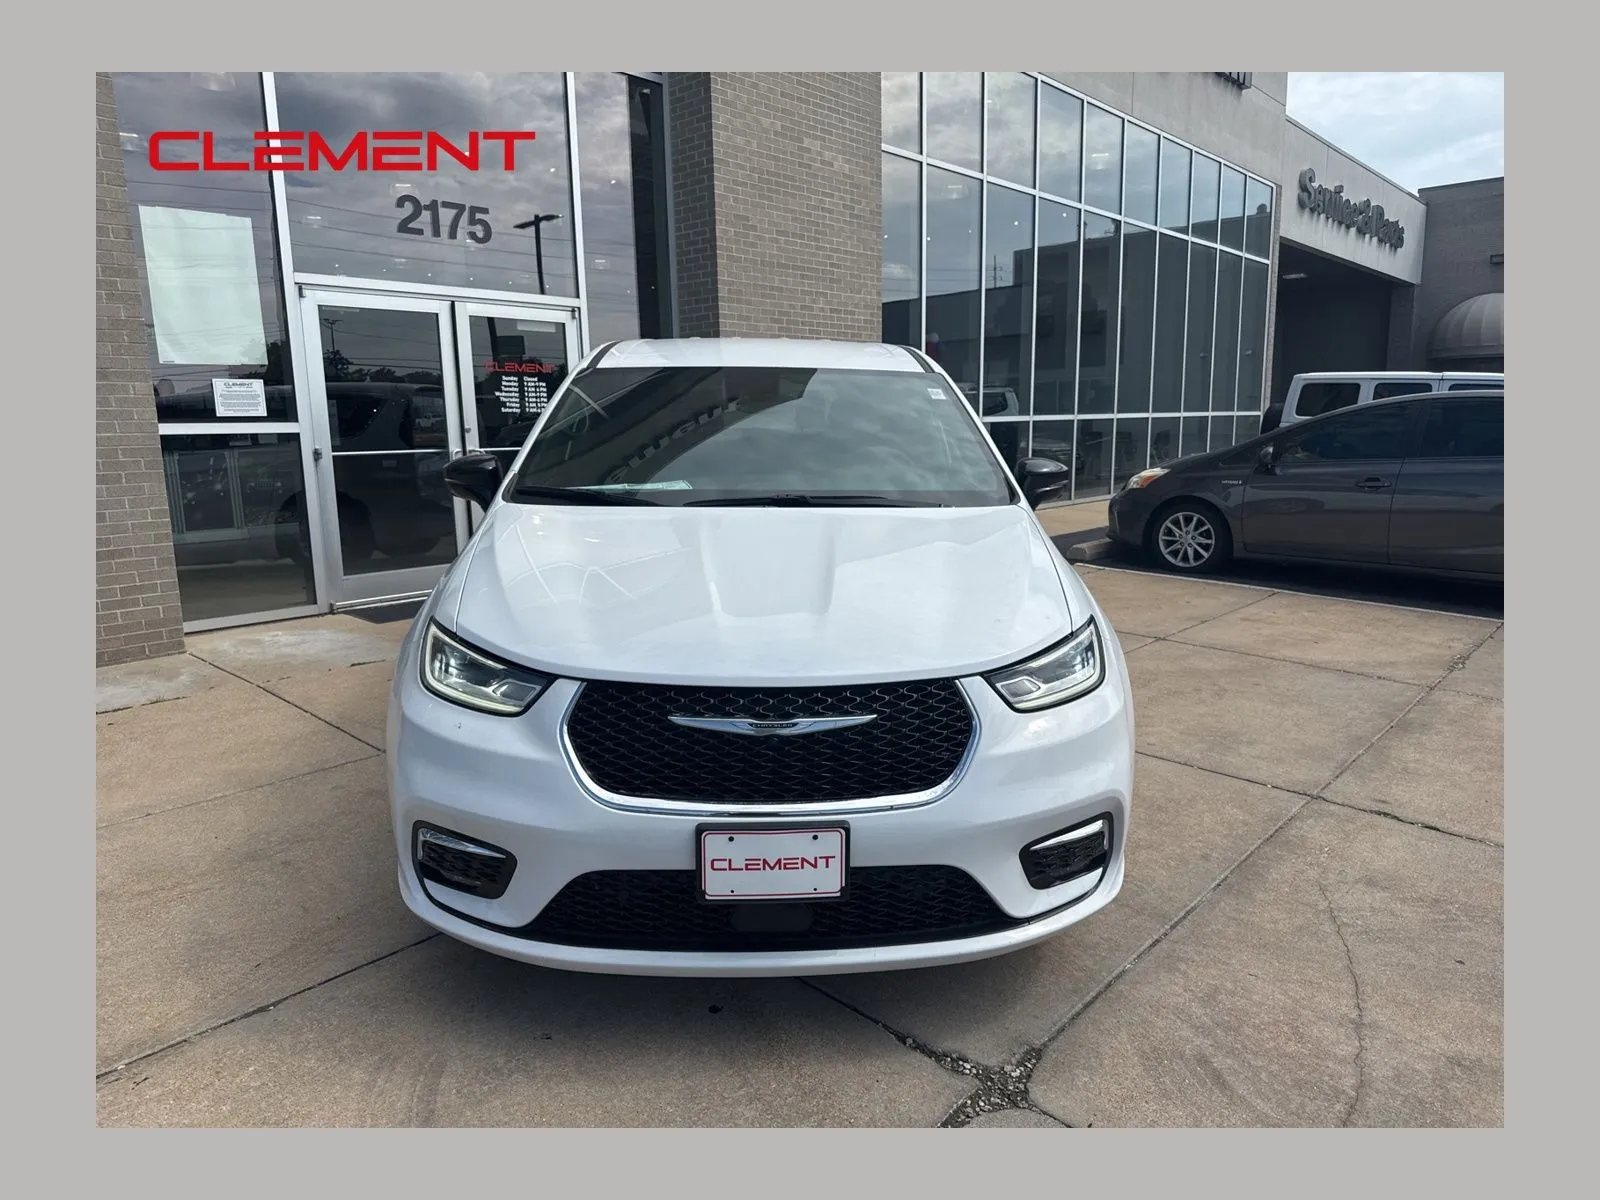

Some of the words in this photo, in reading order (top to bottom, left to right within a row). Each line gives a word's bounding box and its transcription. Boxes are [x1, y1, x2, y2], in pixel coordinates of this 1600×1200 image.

[1297, 167, 1358, 228] Service
[395, 194, 493, 244] 2175
[485, 360, 556, 373] CLEMENT
[710, 855, 836, 871] CLEMENT
